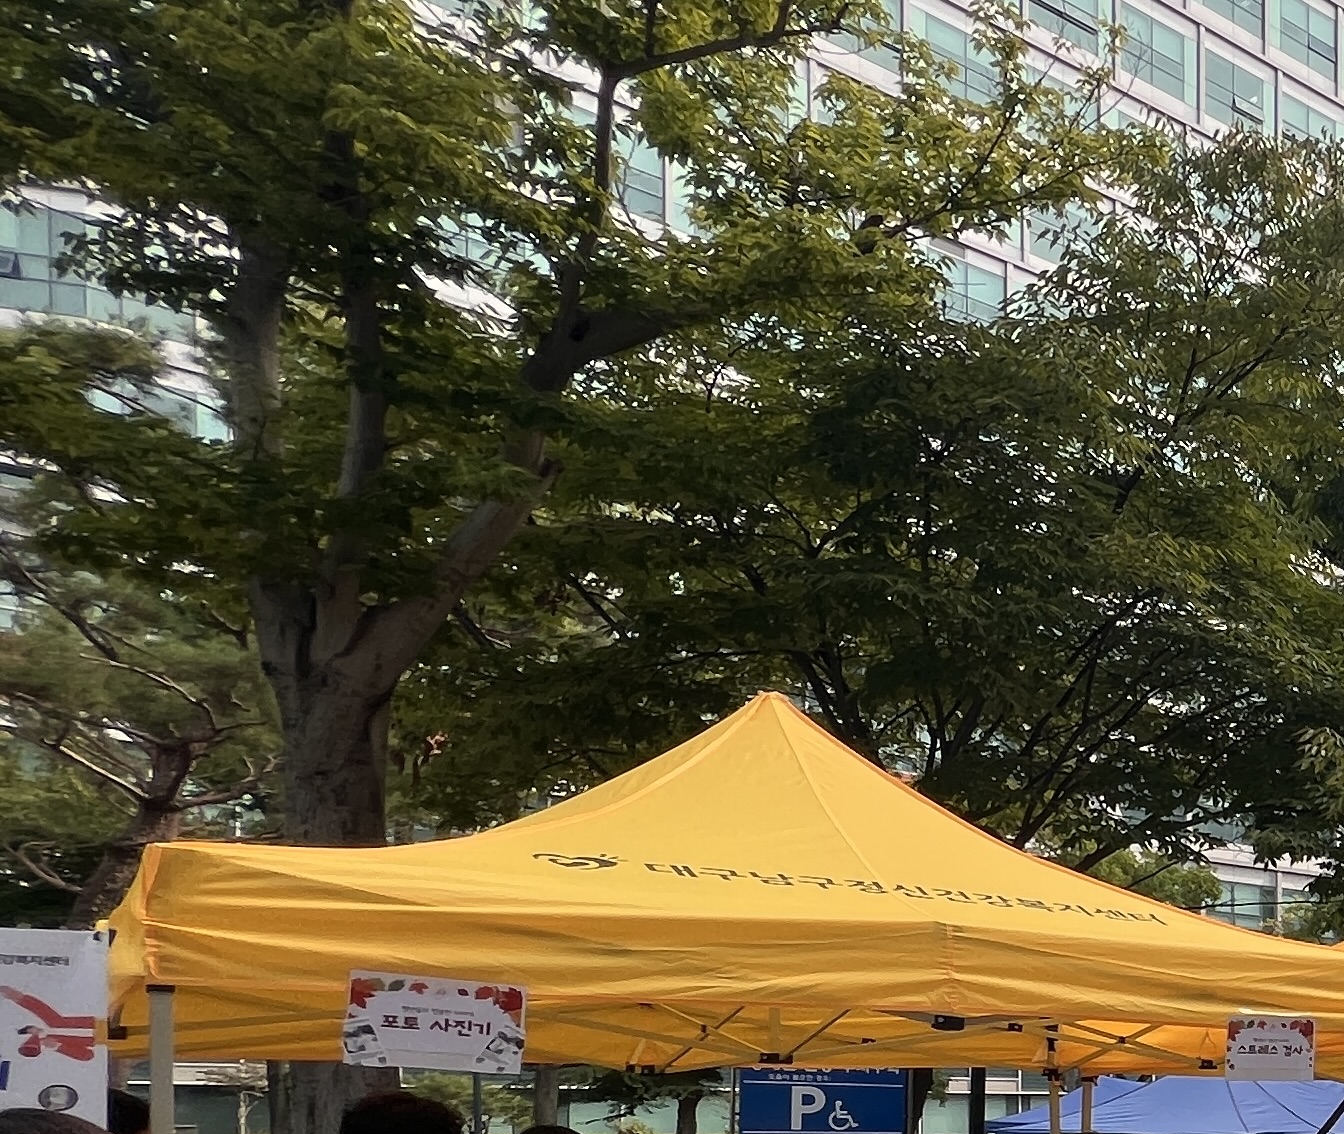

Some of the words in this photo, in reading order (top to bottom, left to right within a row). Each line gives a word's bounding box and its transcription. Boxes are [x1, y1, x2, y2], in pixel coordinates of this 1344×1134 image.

[643, 862, 1168, 927] 대구남구정신건강복지센터
[380, 1014, 420, 1031] 포토
[429, 1018, 491, 1037] 사진기
[1237, 1045, 1278, 1055] 스트레스
[1282, 1045, 1304, 1057] 검사
[790, 1085, 826, 1131] P
